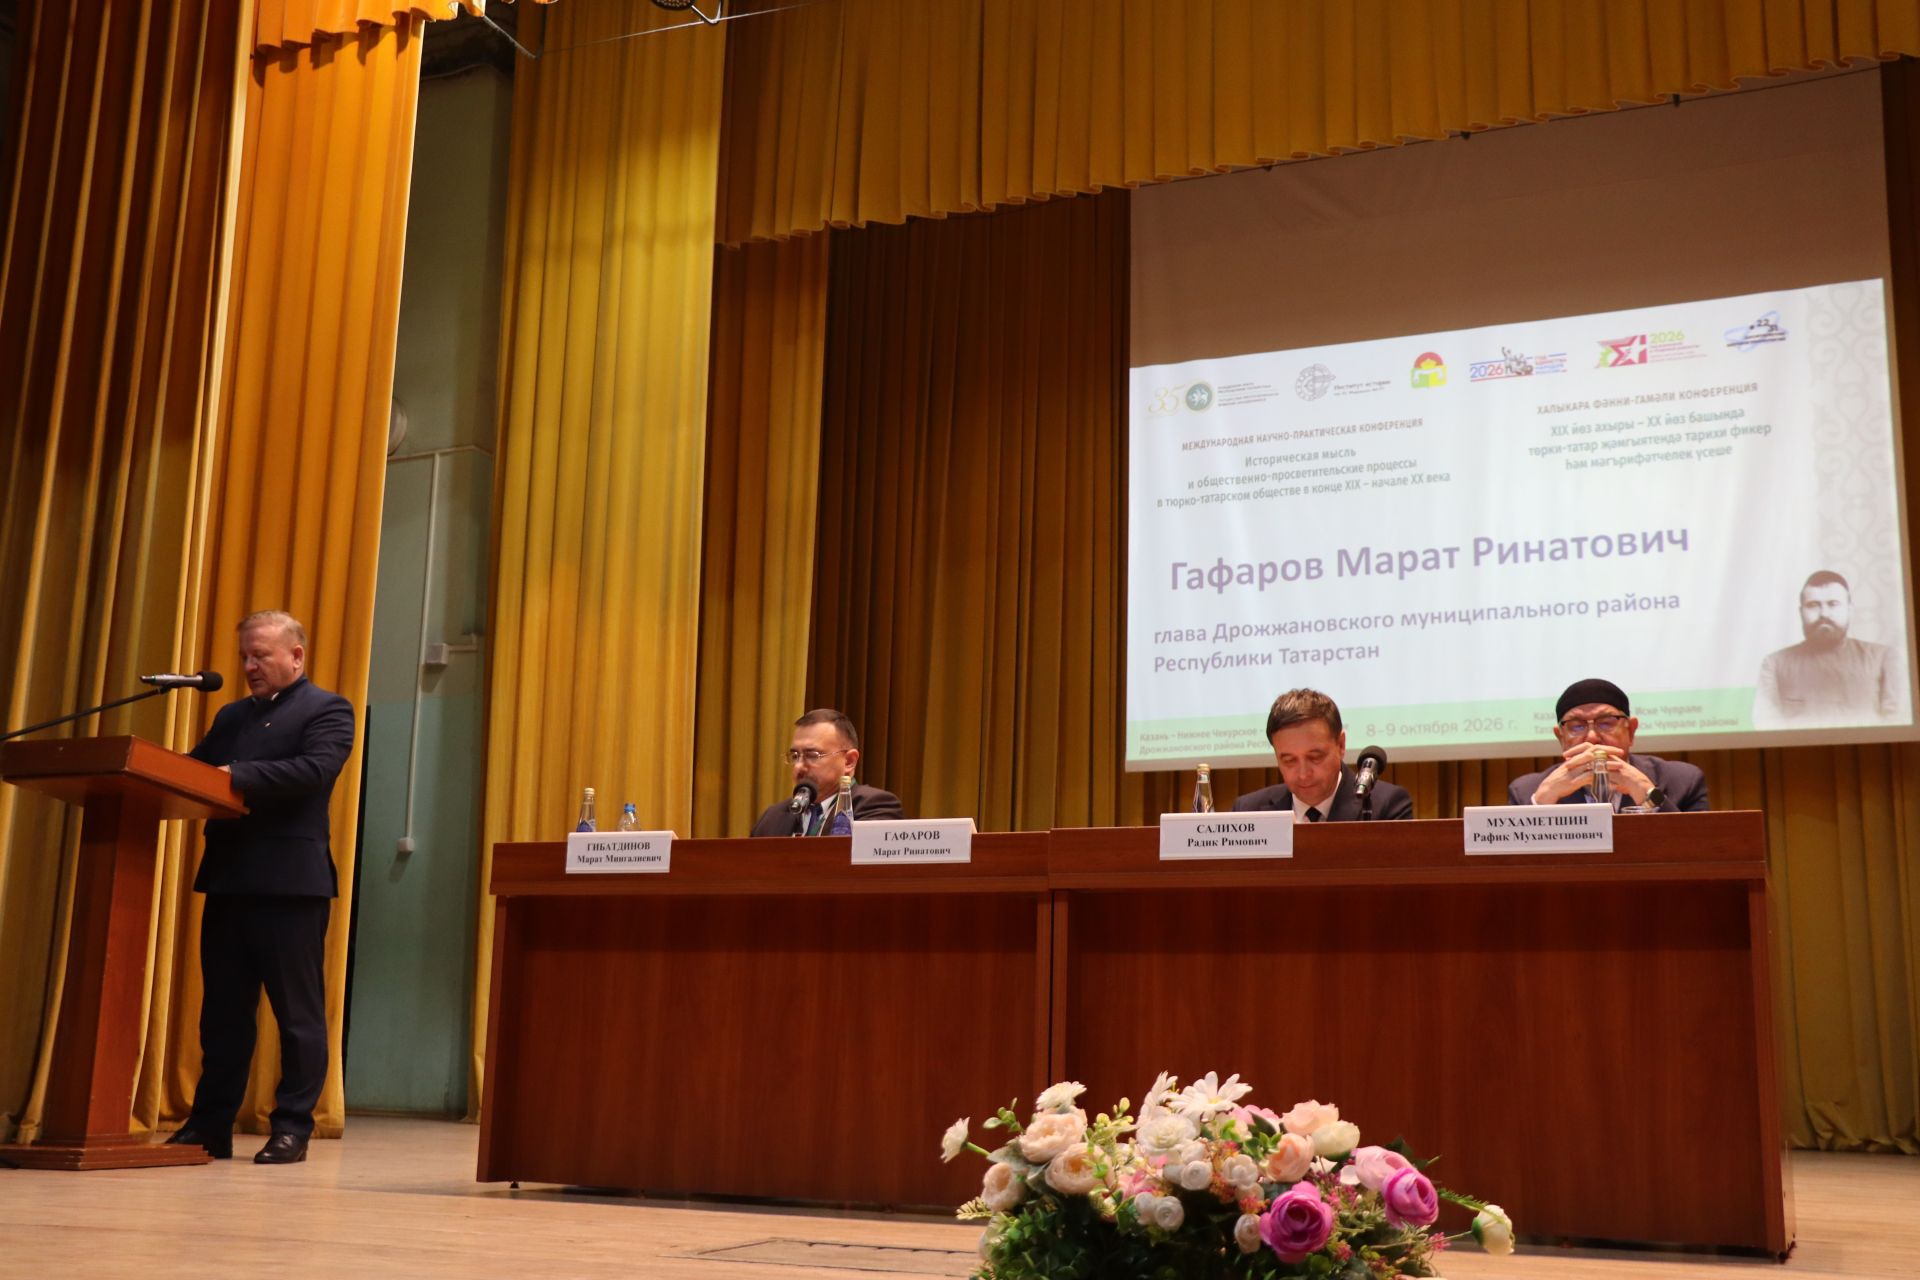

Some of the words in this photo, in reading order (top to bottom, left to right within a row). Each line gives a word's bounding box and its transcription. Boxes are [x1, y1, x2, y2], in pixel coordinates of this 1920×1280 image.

[1649, 330, 1684, 343] 2026
[1470, 363, 1504, 378] 2026
[1537, 401, 1590, 415] ХАЛЫКАРА
[1679, 382, 1758, 400] КОНФЕРЕНЦИЯ
[1595, 421, 1634, 433] ахыры
[1688, 408, 1745, 423] башында
[1182, 435, 1254, 451] МЕЖДУНАРОДНАЯ
[1257, 424, 1357, 443] НАУЧНО-ПРАКТИЧЕСКАЯ
[1359, 418, 1423, 433] КОНФЕРЕНЦИЯ
[1685, 429, 1727, 443] тарихи
[1730, 423, 1772, 438] фикер
[1245, 452, 1319, 467] Историческая
[1322, 448, 1357, 459] мысль
[1696, 446, 1732, 461] үсеше
[1188, 481, 1195, 489] и
[1197, 463, 1364, 489] общественно-просветительские
[1366, 459, 1417, 473] процессы
[1157, 499, 1163, 507] в
[1166, 491, 1250, 509] тюрко-татарском
[1252, 486, 1301, 500] обществе
[1303, 486, 1309, 494] в
[1312, 481, 1342, 493] конце
[1345, 479, 1361, 491] XIX
[1371, 477, 1408, 488] начале
[1411, 473, 1424, 485] XX
[1426, 472, 1451, 483] века
[1170, 552, 1324, 595] Гафаров
[1335, 545, 1460, 581] Марат
[1473, 527, 1690, 567] Ринатович
[1153, 625, 1208, 646] глава
[1213, 612, 1395, 645] Дрожжановского
[1399, 597, 1589, 629] муниципального
[1595, 591, 1681, 619] района
[1153, 650, 1273, 675] Республики
[1278, 641, 1380, 666] Татарстан
[1400, 720, 1458, 736] октября
[1464, 717, 1504, 732] 2026
[1508, 719, 1519, 730] г.
[1196, 823, 1255, 834] САЛИХОВ
[1487, 815, 1588, 828] МУХАМЕТШИН
[884, 830, 940, 841] ГАФАРОВ
[1187, 838, 1218, 847] Радик
[1221, 837, 1267, 847] Римович
[1473, 832, 1510, 844] Рафик
[587, 842, 651, 851] ГИБАТДИНОВ
[873, 847, 900, 858] Марат
[903, 846, 951, 856] Ринатович
[577, 855, 603, 864] Марат
[605, 854, 662, 863] Мингалиевич
